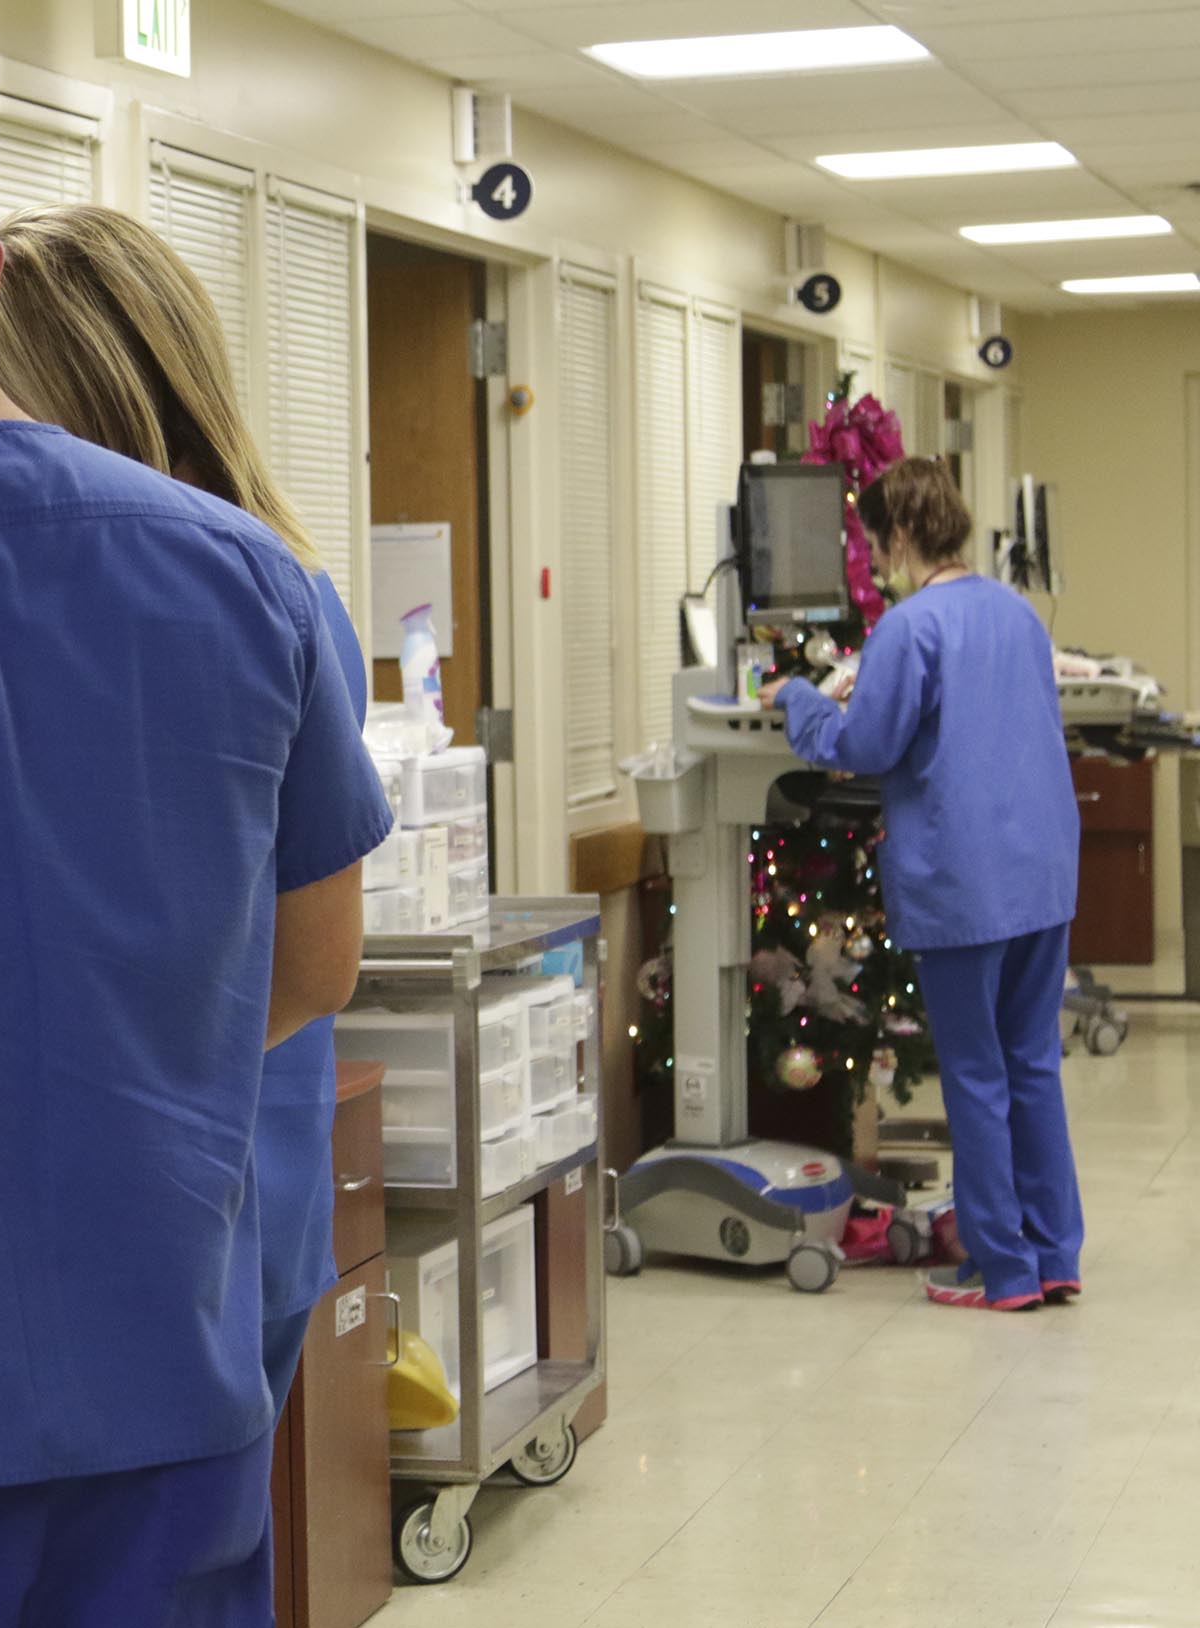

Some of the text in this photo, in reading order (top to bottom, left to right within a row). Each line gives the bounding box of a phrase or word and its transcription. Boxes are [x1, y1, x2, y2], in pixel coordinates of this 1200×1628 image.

[491, 173, 517, 210] 4
[814, 281, 830, 308] 5
[986, 341, 1004, 365] 6
